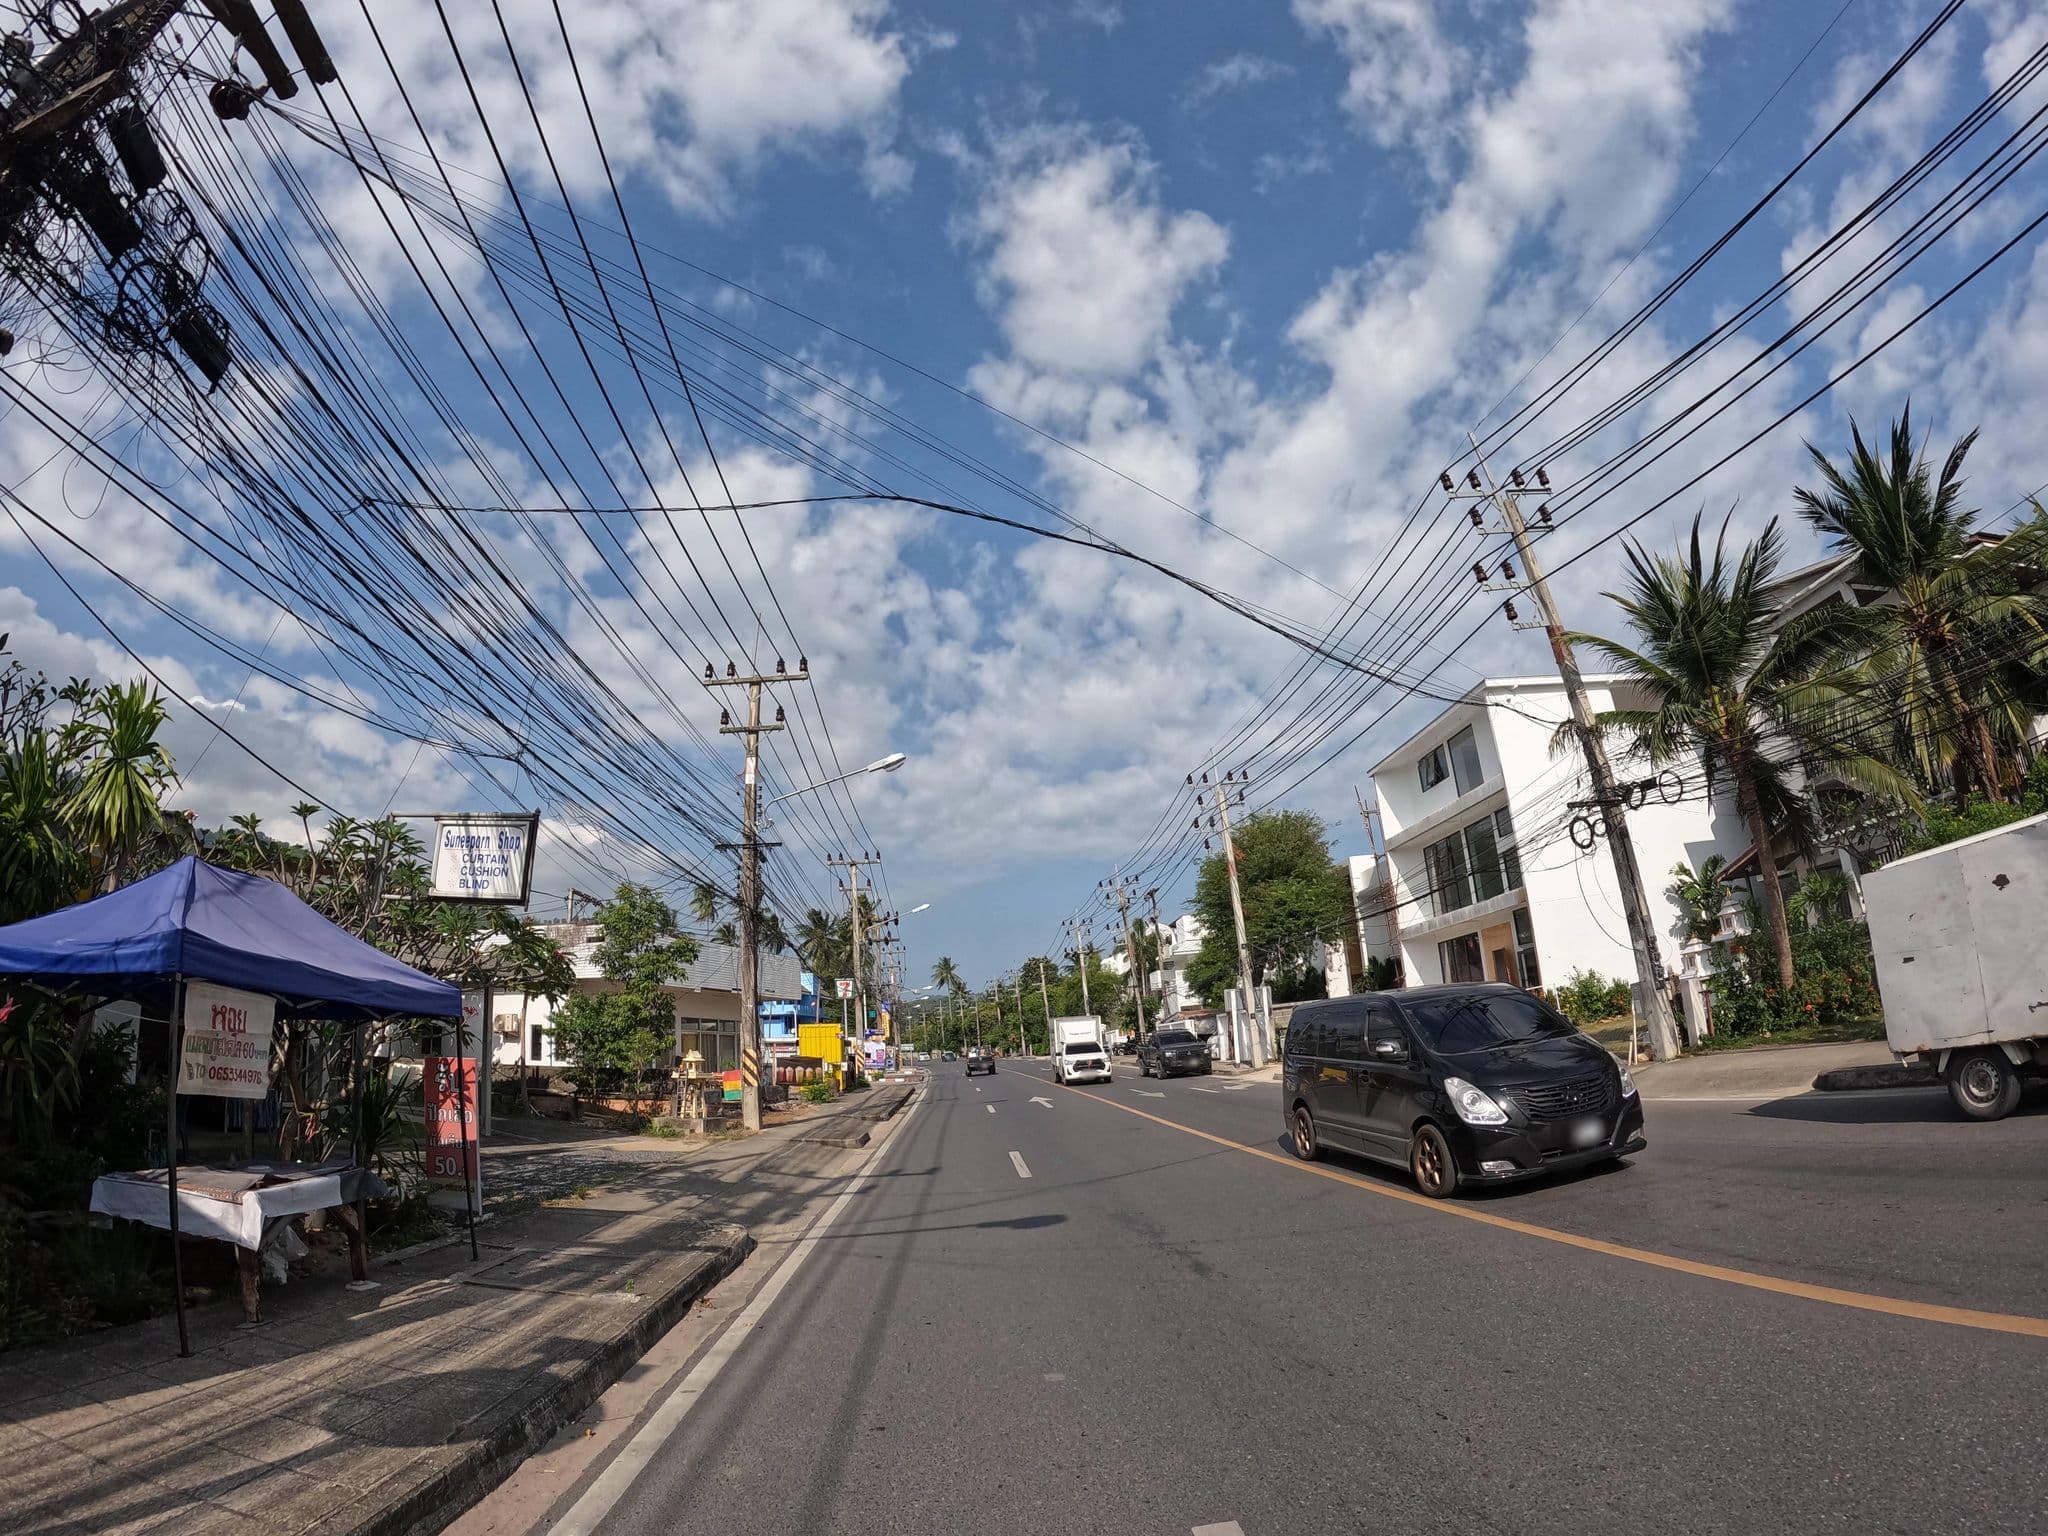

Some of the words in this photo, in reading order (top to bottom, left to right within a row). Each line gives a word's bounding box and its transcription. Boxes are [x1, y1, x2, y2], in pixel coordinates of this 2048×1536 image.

[498, 831, 521, 853] Shop
[462, 854, 509, 865] CURTAIN
[460, 866, 509, 877] CUSHION
[458, 878, 490, 890] BLIND
[211, 1004, 248, 1034] หอย
